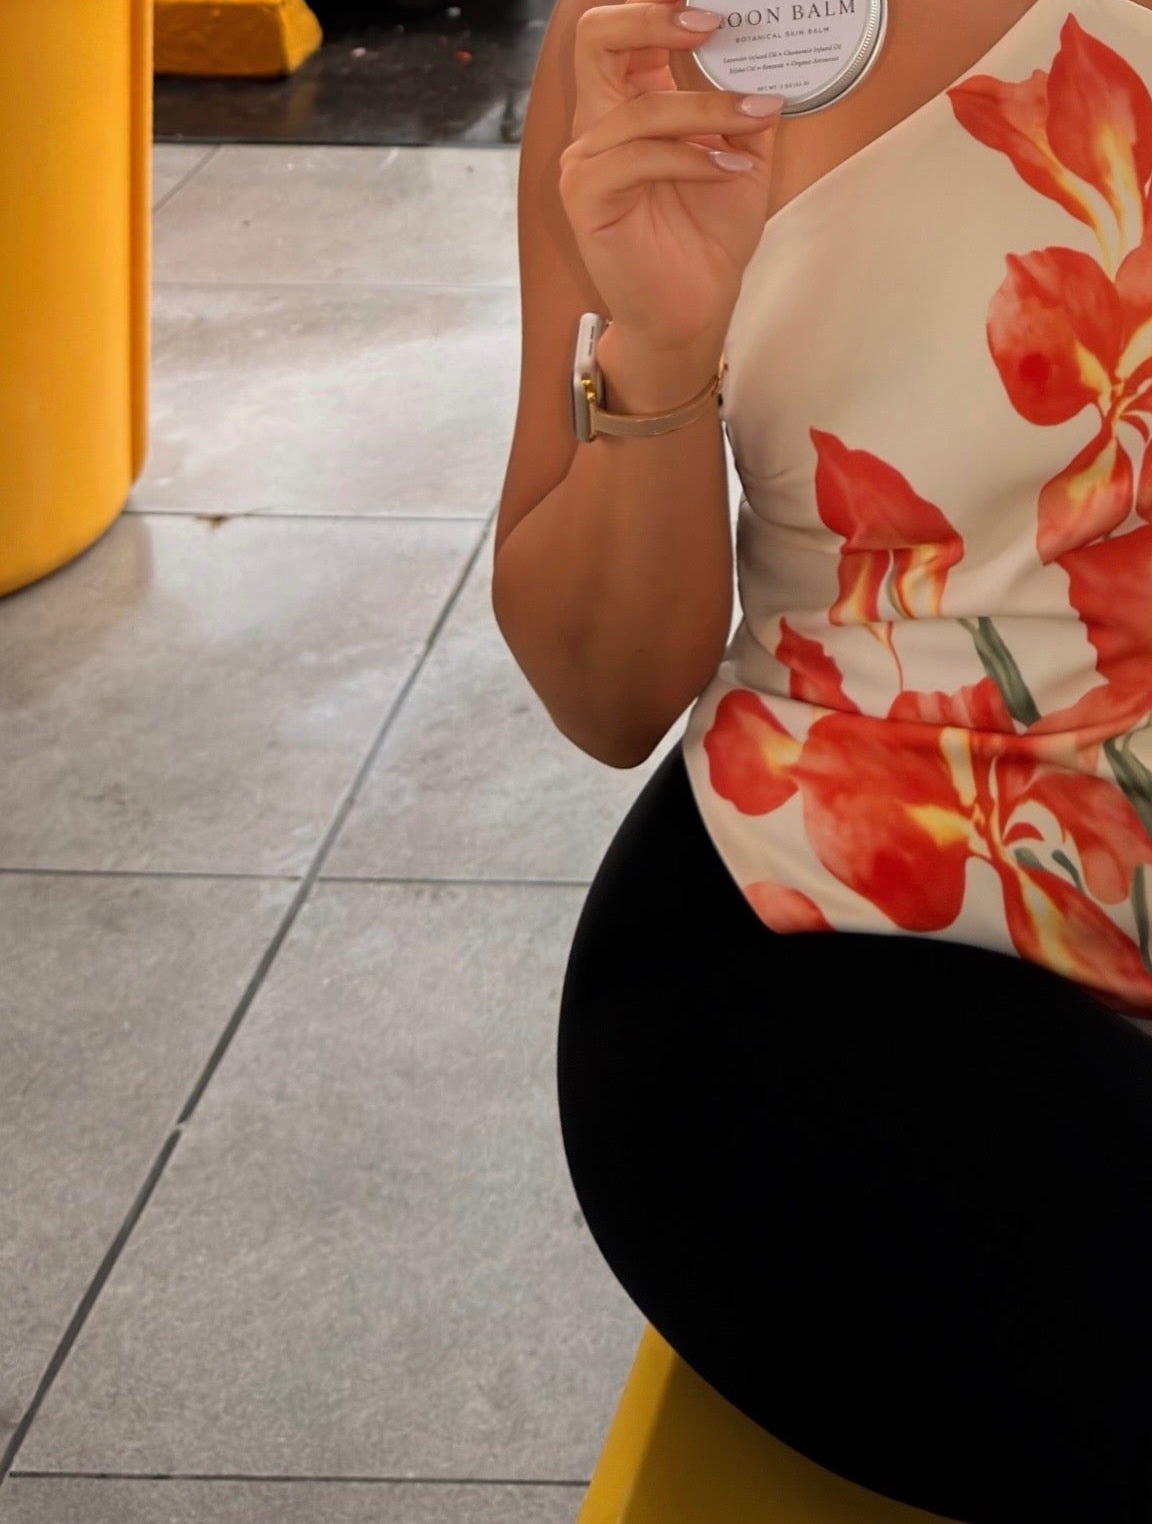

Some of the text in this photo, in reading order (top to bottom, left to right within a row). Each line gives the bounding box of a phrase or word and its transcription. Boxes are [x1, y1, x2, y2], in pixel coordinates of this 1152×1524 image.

[717, 6, 781, 30] OON
[735, 26, 830, 44] BOTANICAL SKIN BALM
